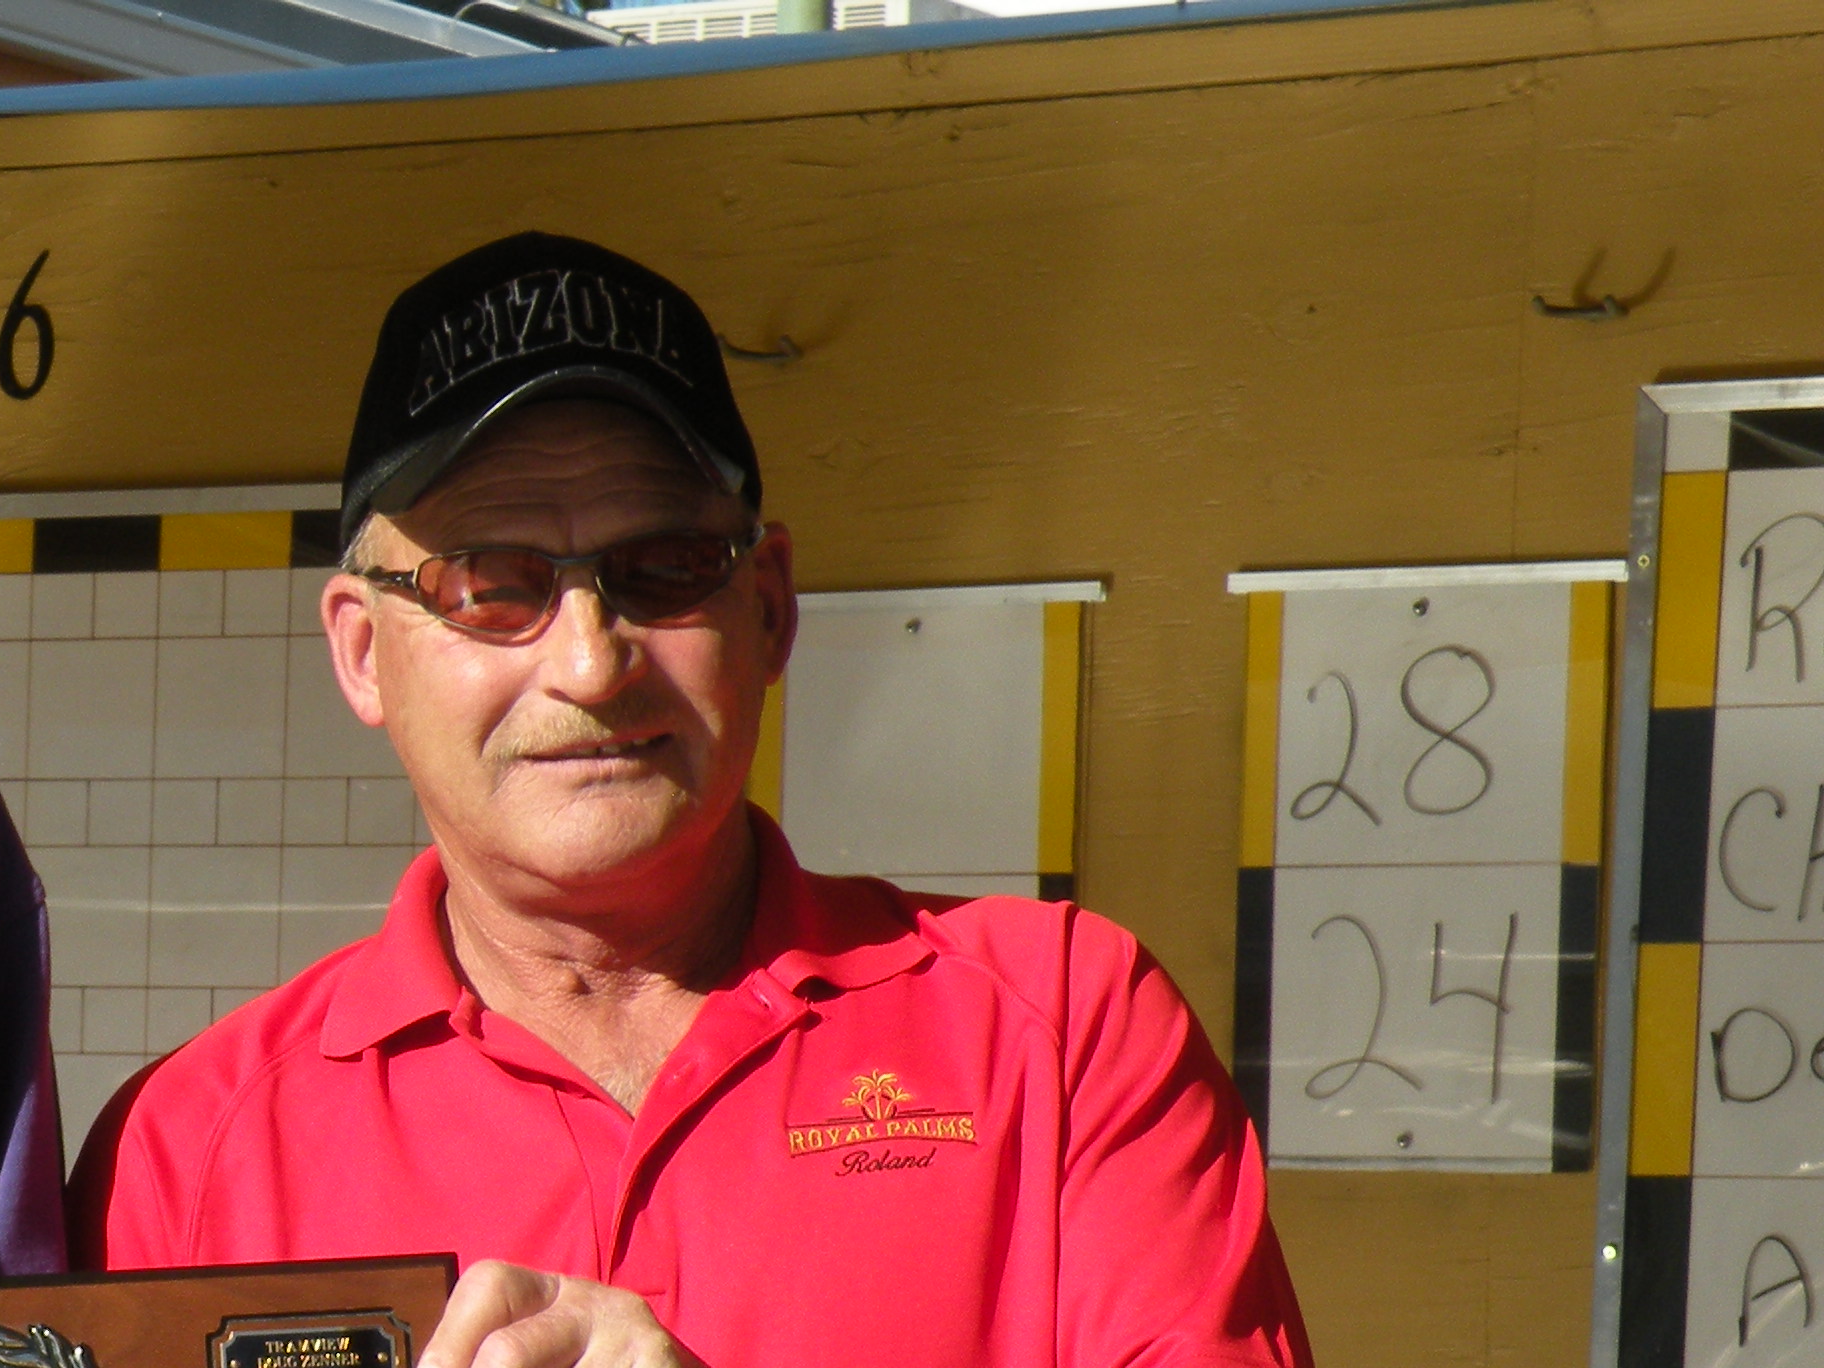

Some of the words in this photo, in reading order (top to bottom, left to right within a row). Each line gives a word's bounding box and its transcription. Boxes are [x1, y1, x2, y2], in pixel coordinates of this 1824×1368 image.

[1289, 643, 1496, 827] 28
[1303, 909, 1519, 1104] 24
[788, 1124, 878, 1153] ROYAL
[886, 1116, 977, 1141] PALMS
[833, 1146, 938, 1178] Roland
